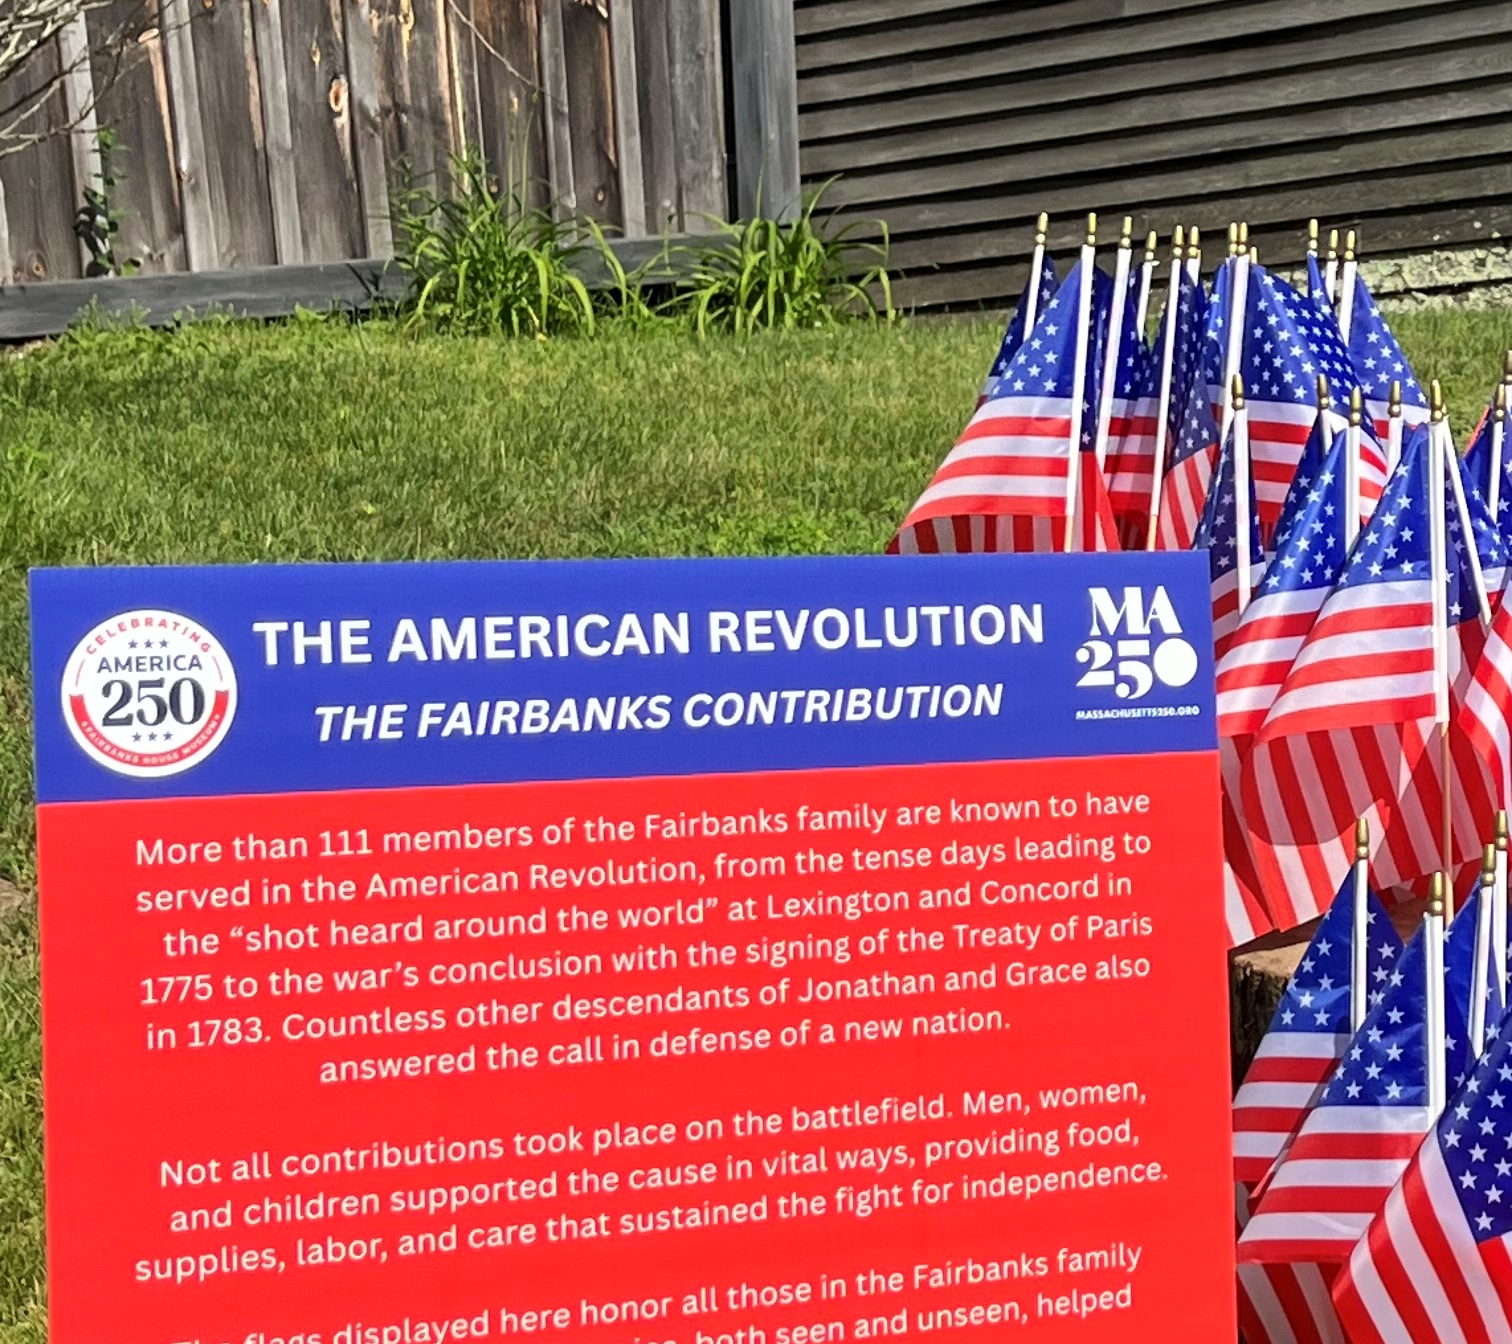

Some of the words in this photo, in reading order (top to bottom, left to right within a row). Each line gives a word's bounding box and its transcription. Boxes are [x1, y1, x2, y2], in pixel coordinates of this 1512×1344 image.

[86, 617, 212, 655] CELEBRATING
[252, 620, 372, 666] THE
[387, 612, 690, 663] AMERICAN
[708, 603, 1044, 653] REVOLUTION
[1088, 584, 1183, 636] MA
[96, 654, 203, 674] AMERICA
[1075, 637, 1198, 700] 250
[101, 677, 206, 727] 250
[315, 704, 408, 742] THE
[417, 694, 672, 738] FAIRBANKS
[683, 683, 1004, 728] CONTRIBUTION
[136, 838, 222, 866] More
[232, 833, 308, 861] than
[319, 829, 373, 857] 111
[383, 822, 533, 853] members
[543, 816, 576, 845] of
[583, 816, 635, 843] the
[645, 808, 789, 839] Fairbanks
[796, 802, 888, 834] family
[896, 805, 941, 826] are
[950, 798, 1040, 823] known
[1048, 795, 1077, 818] to
[1086, 791, 1150, 816] have
[136, 879, 250, 913] served
[262, 878, 291, 905] in
[301, 875, 356, 903] the
[365, 867, 519, 899] American
[530, 856, 706, 889] Revolution,
[714, 852, 786, 879] from
[794, 848, 844, 875] the
[851, 847, 932, 871] tense
[941, 840, 1007, 871] days
[1015, 833, 1116, 863] leading
[1122, 832, 1151, 855] to
[163, 928, 219, 957] the
[230, 923, 319, 952] “shot
[330, 914, 423, 946] heard
[434, 907, 547, 940] around
[556, 905, 608, 932] the
[617, 897, 718, 929] world”
[728, 897, 758, 922] at
[767, 890, 910, 921] Lexington
[918, 881, 971, 909] and
[980, 873, 1099, 905] Concord
[1108, 872, 1132, 896] in
[141, 974, 213, 1005] 1775
[223, 975, 258, 999] to
[268, 968, 323, 996] the
[333, 961, 420, 991] war’s
[429, 950, 602, 985] conclusion
[611, 943, 677, 972] with
[686, 940, 737, 968] the
[745, 933, 851, 968] signing
[859, 927, 890, 956] of
[896, 927, 944, 953] the
[952, 922, 1042, 951] Treaty
[1050, 915, 1079, 942] of
[1087, 911, 1153, 939] Paris
[147, 1023, 177, 1050] in
[187, 1016, 271, 1048] 1783.
[282, 1006, 446, 1040] Countless
[456, 999, 543, 1028] other
[552, 985, 750, 1021] descendants
[759, 977, 791, 1006] of
[798, 970, 935, 1003] Jonathan
[944, 963, 997, 992] and
[1006, 961, 1087, 987] Grace
[1095, 954, 1150, 980] also
[320, 1044, 475, 1083] answered
[486, 1042, 539, 1070] the
[548, 1035, 604, 1065] call
[613, 1034, 640, 1060] in
[649, 1027, 771, 1057] defense
[780, 1018, 812, 1047] of
[819, 1023, 836, 1044] a
[845, 1018, 903, 1041] new
[912, 1007, 1010, 1036] nation.
[160, 1158, 222, 1187] Not
[232, 1151, 272, 1181] all
[281, 1136, 504, 1177] contributions
[513, 1125, 583, 1157] took
[593, 1121, 677, 1156] place
[685, 1119, 723, 1141] on
[732, 1110, 783, 1137] the
[792, 1093, 953, 1132] battlefield.
[963, 1090, 1031, 1116] Men,
[1039, 1081, 1146, 1109] women,
[170, 1199, 232, 1232] and
[244, 1191, 380, 1225] children
[390, 1171, 557, 1215] supported
[567, 1168, 619, 1196] the
[629, 1162, 717, 1190] cause
[727, 1154, 753, 1181] in
[762, 1146, 828, 1177] vital
[836, 1145, 915, 1173] ways,
[925, 1128, 1060, 1168] providing
[1066, 1117, 1139, 1147] food,
[135, 1245, 286, 1284] supplies,
[297, 1236, 388, 1266] labor,
[398, 1224, 457, 1256] and
[468, 1223, 537, 1249] care
[545, 1213, 611, 1242] that
[620, 1194, 768, 1235] sustained
[777, 1191, 827, 1219] the
[835, 1184, 903, 1218] fight
[911, 1178, 954, 1205] for
[962, 1162, 1168, 1200] independence.
[500, 1307, 571, 1334] here
[580, 1297, 673, 1325] honor
[682, 1286, 719, 1315] all
[727, 1282, 812, 1310] those
[821, 1273, 847, 1299] in
[856, 1268, 904, 1296] the
[913, 1252, 1049, 1289] Fairbanks
[1057, 1241, 1142, 1273] family
[854, 1308, 908, 1339] and
[917, 1301, 1028, 1332] unseen,
[1037, 1282, 1132, 1318] helped
